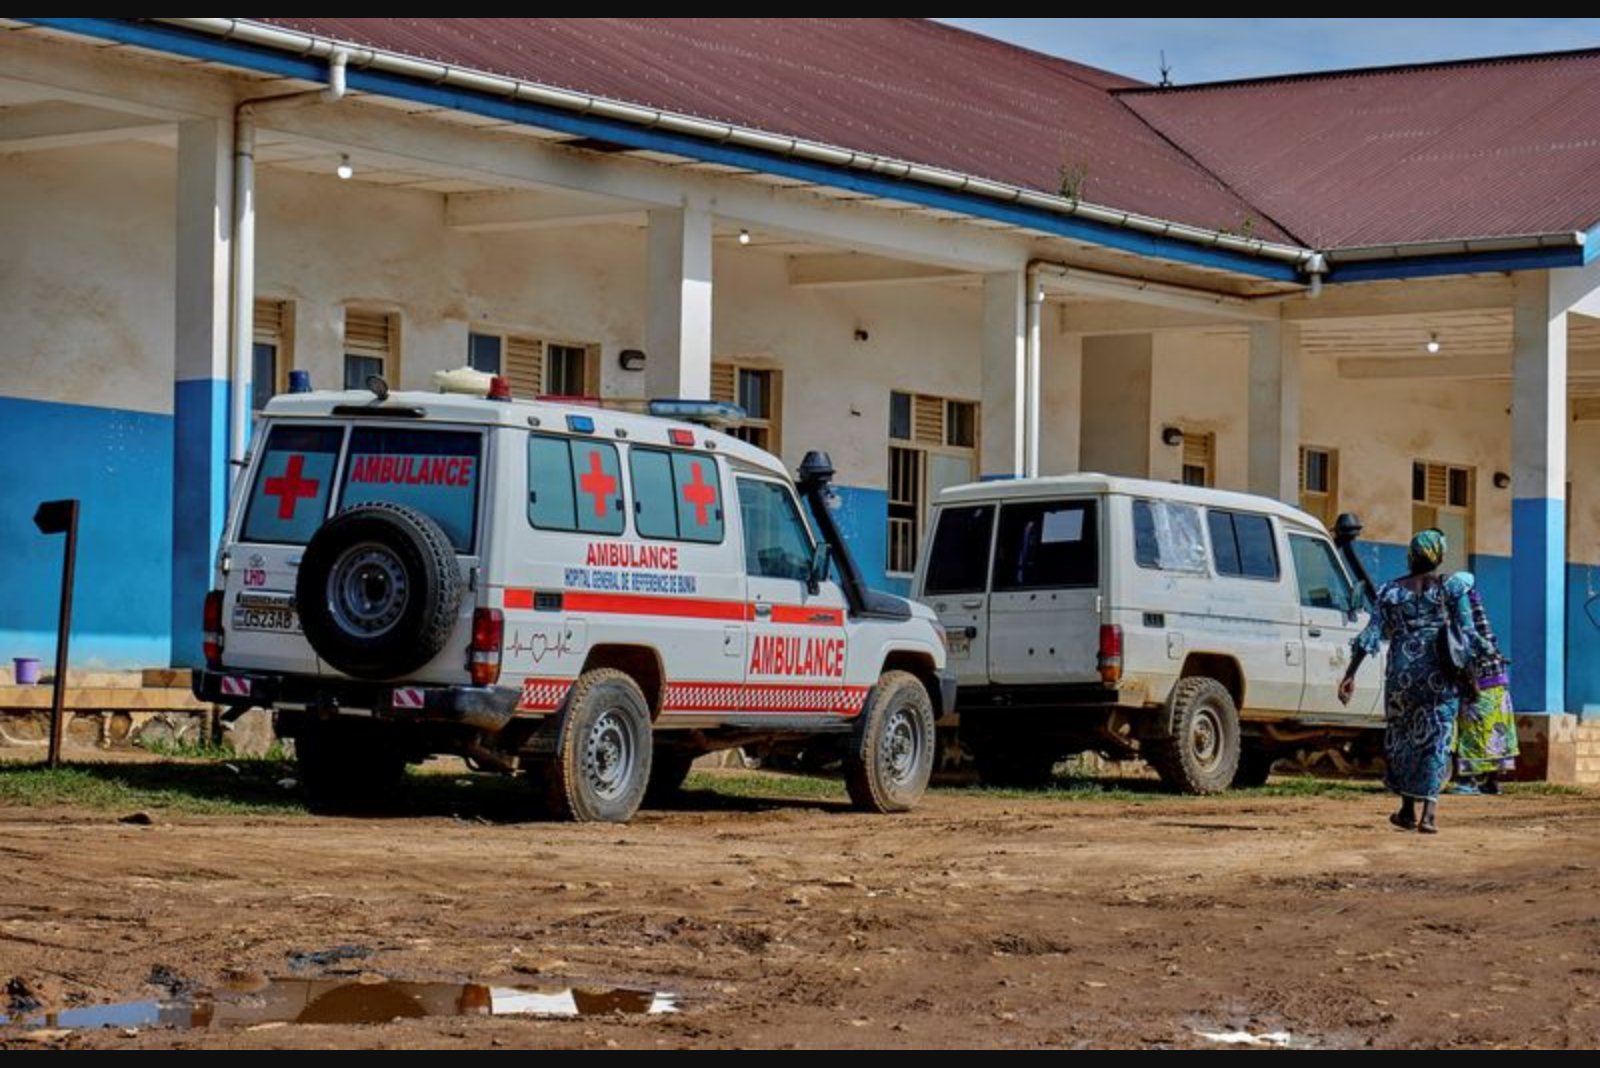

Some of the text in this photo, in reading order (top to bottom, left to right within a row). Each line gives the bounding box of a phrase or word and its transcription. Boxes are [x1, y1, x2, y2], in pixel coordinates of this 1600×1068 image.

[352, 457, 472, 486] AMBULANCE
[586, 543, 678, 570] AMBULANCE
[243, 568, 267, 586] LHD
[621, 572, 630, 591] DE
[750, 636, 845, 677] AMBULANCE
